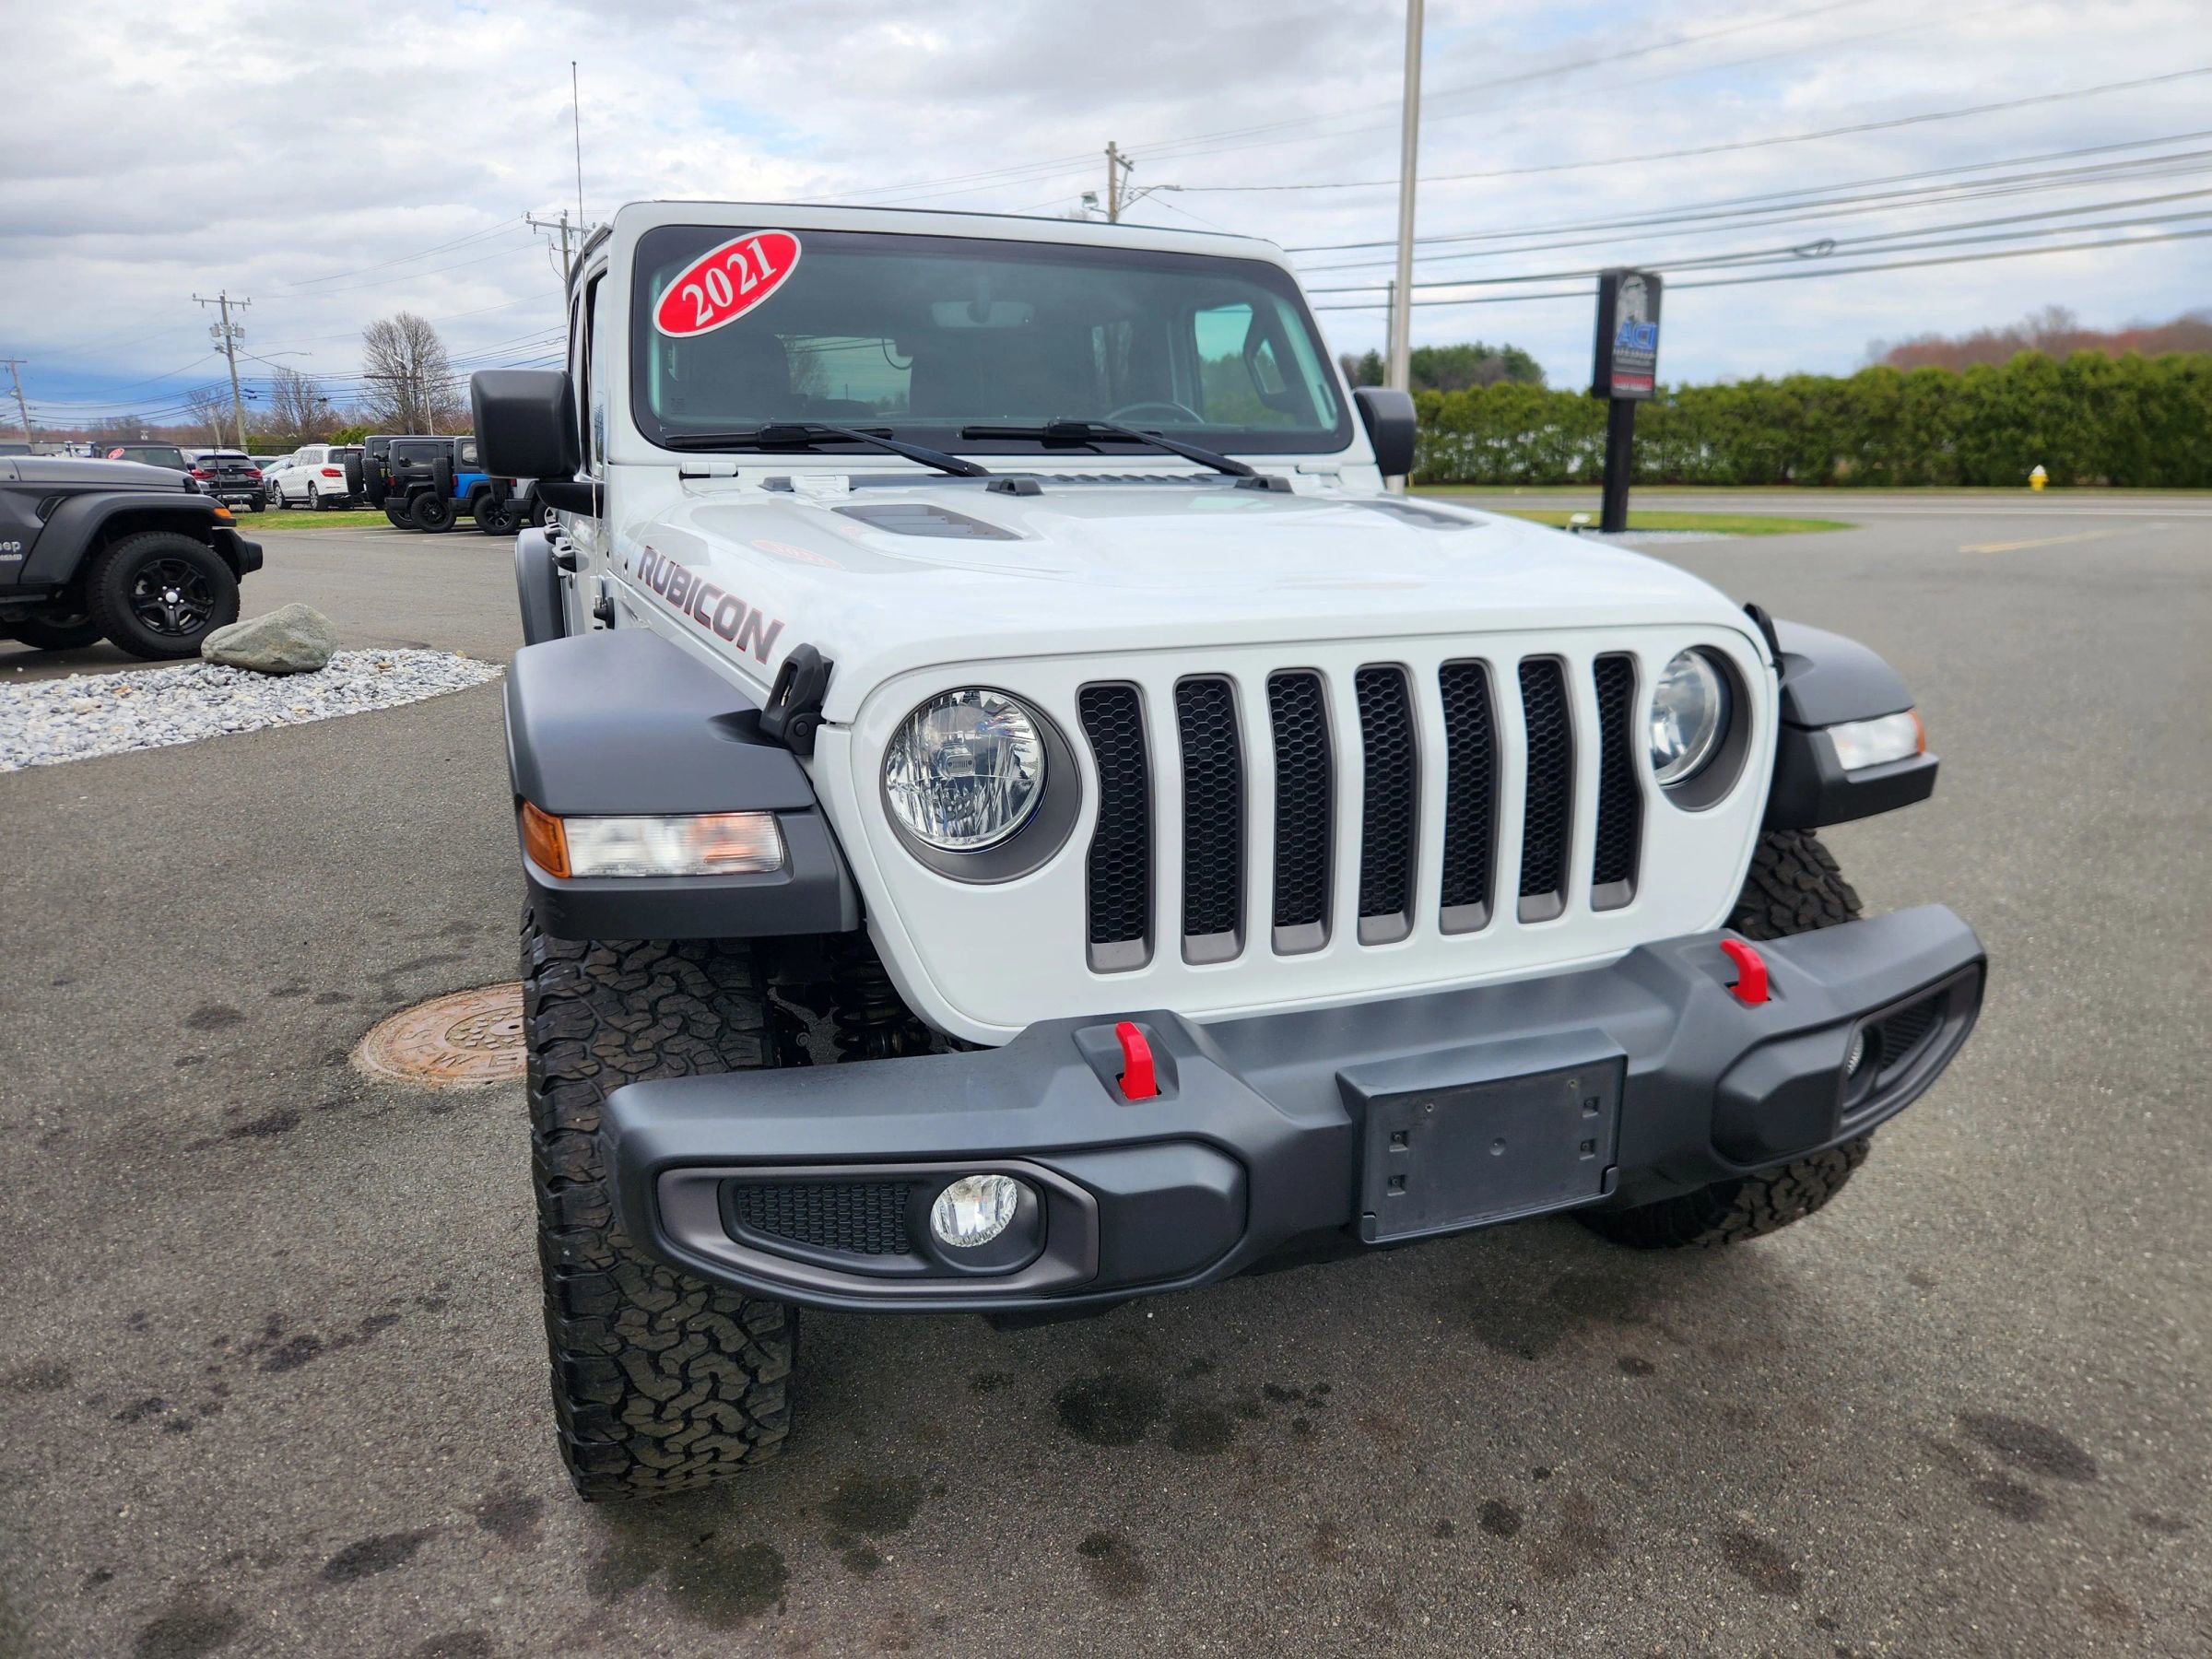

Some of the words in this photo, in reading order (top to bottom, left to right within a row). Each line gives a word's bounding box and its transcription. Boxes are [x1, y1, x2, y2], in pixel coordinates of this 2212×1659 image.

[682, 238, 777, 327] 2021
[0, 541, 21, 553] ep
[637, 545, 785, 665] RUBICON
